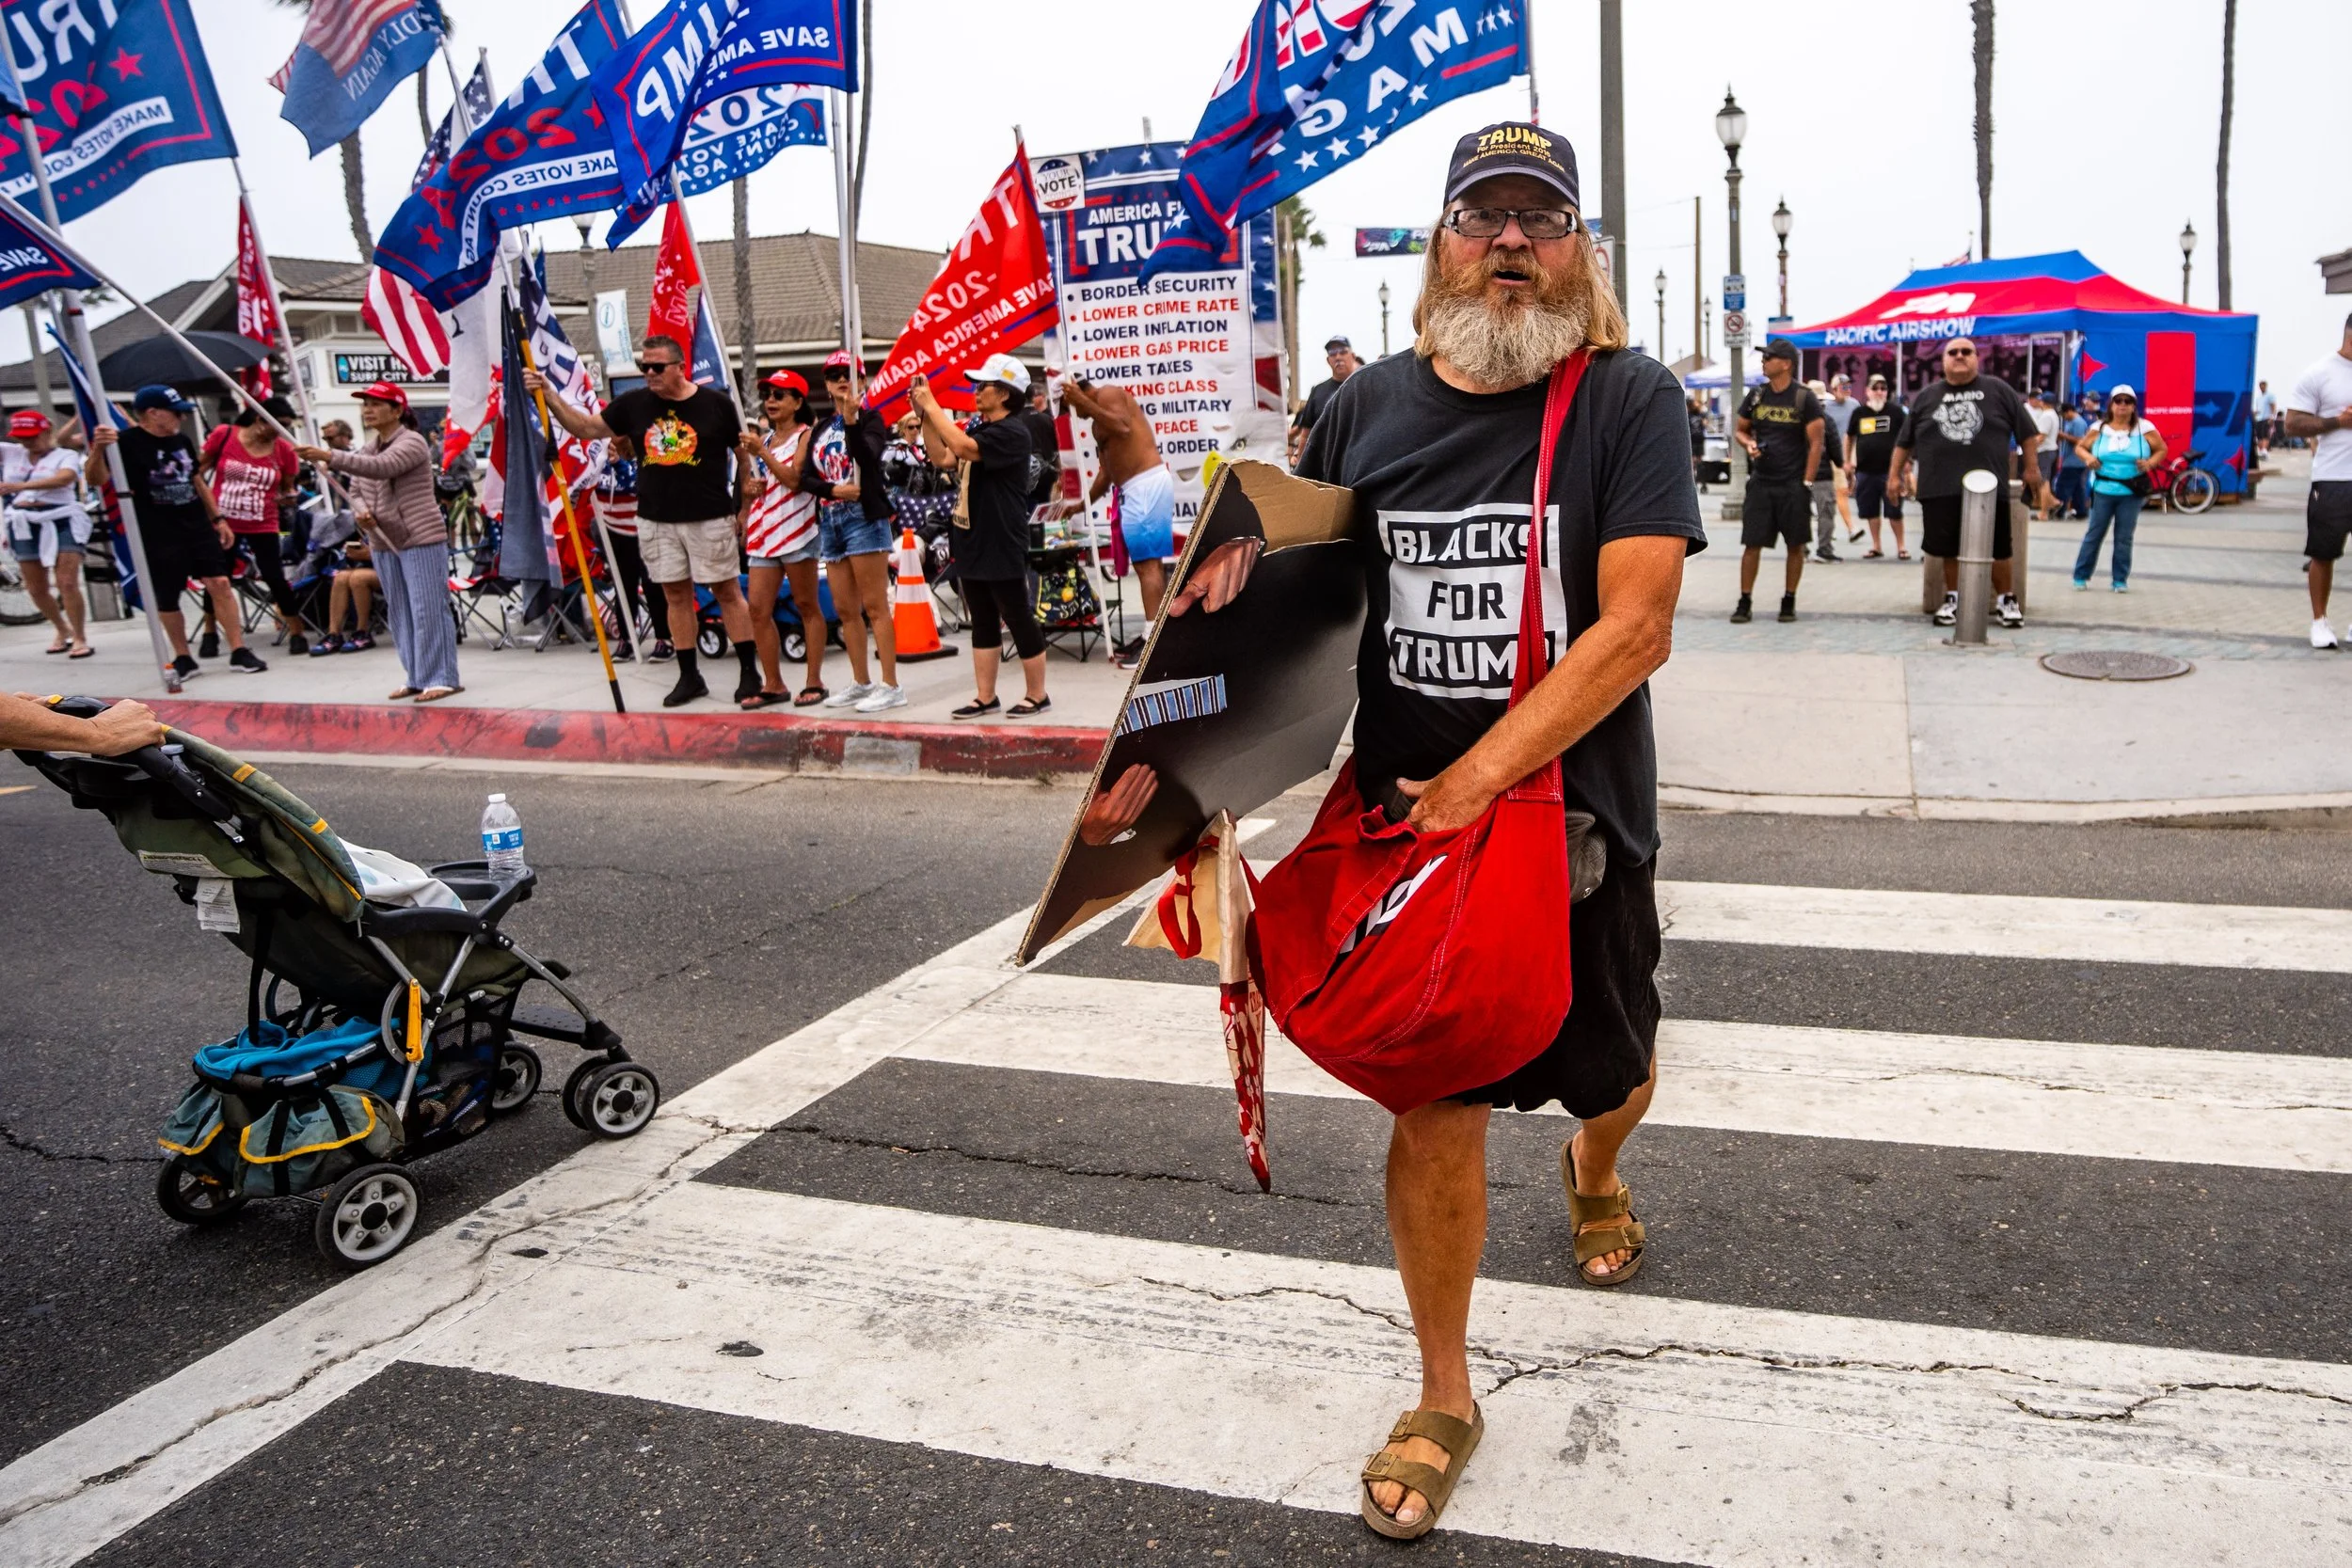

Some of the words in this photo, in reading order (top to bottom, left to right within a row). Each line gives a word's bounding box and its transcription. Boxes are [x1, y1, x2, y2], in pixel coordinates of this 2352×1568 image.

[1476, 145, 1488, 153] For
[1478, 127, 1552, 149] TRUMP
[1462, 155, 1480, 167] MAKE
[1479, 149, 1518, 159] AMERICA
[1519, 149, 1547, 161] GREAT
[1039, 175, 1076, 195] VOTE
[1042, 169, 1070, 181] YOUR
[1088, 200, 1163, 226] AMERICA
[1077, 220, 1172, 266] TRU
[1082, 282, 1150, 302] BORDER
[1155, 276, 1238, 294] SECURITY
[1083, 305, 1138, 322] LOWER
[1143, 300, 1191, 315] CRIME
[1197, 297, 1240, 312] RATE
[1084, 325, 1139, 342] LOWER
[1145, 319, 1229, 336] INFLATION
[1825, 323, 1888, 345] PACIFIC
[1888, 316, 1976, 341] AIRSHOW
[1085, 343, 1140, 361] LOWER
[1146, 341, 1173, 356] GAS
[1178, 339, 1229, 353] PRICE
[347, 356, 387, 371] VISIT
[1086, 364, 1142, 381] LOWER
[1147, 359, 1193, 375] TAXES
[350, 372, 379, 383] SURF
[381, 371, 408, 383] CITY
[1124, 382, 1166, 398] KING
[1168, 379, 1218, 393] CLASS
[1942, 390, 1985, 403] MARIO
[1162, 399, 1232, 414] MILITARY
[1154, 419, 1199, 435] PEACE
[1167, 438, 1219, 455] ORDER
[1392, 522, 1534, 563] BLACKS
[1426, 580, 1507, 621] FOR
[1394, 633, 1518, 681] TRUM
